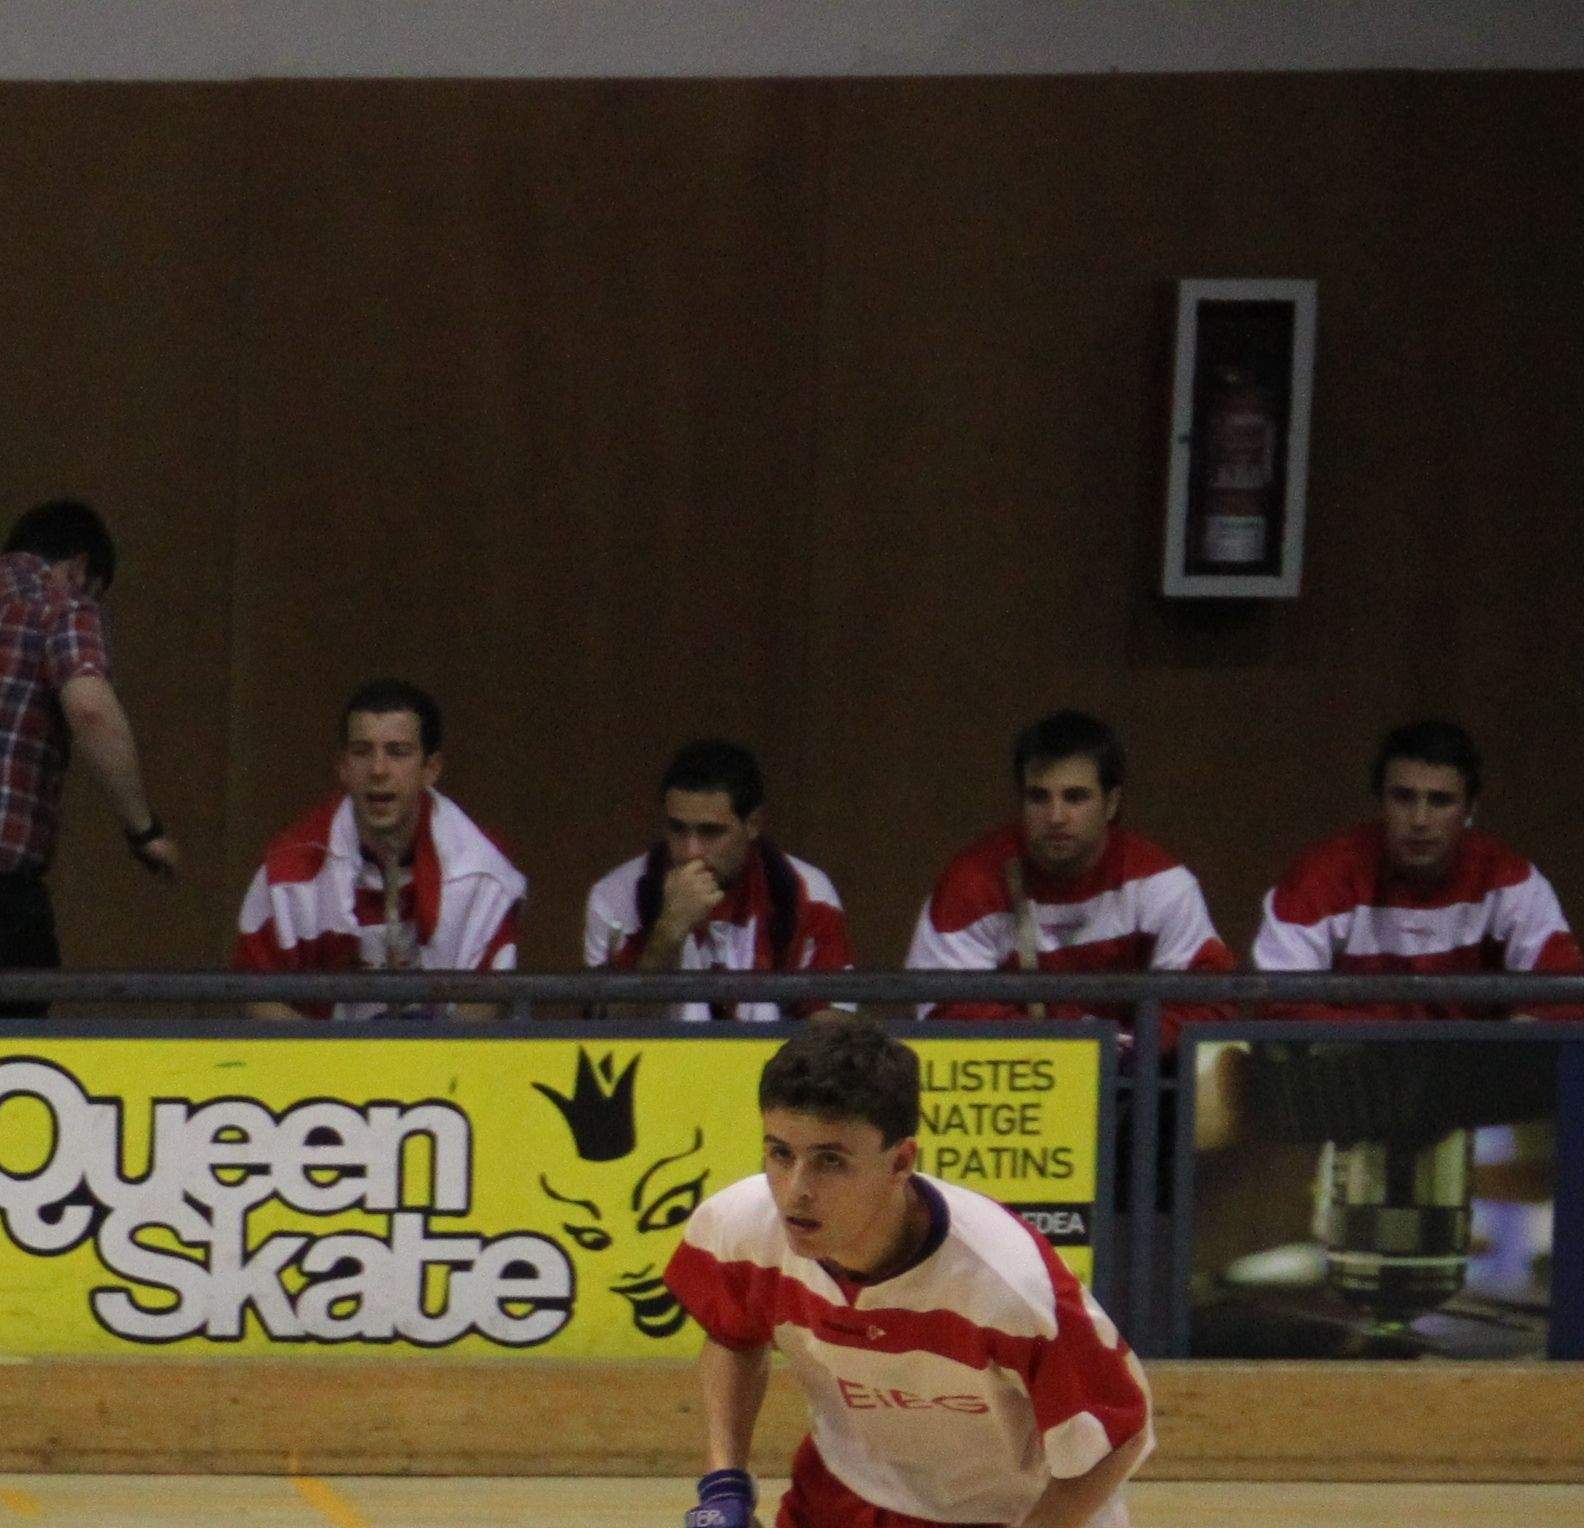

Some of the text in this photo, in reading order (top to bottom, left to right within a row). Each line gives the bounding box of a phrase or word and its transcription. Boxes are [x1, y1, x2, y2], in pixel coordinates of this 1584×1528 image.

[920, 1059, 1055, 1092] LISTES
[936, 1146, 1075, 1180] PATINS
[91, 1202, 576, 1348] Skate
